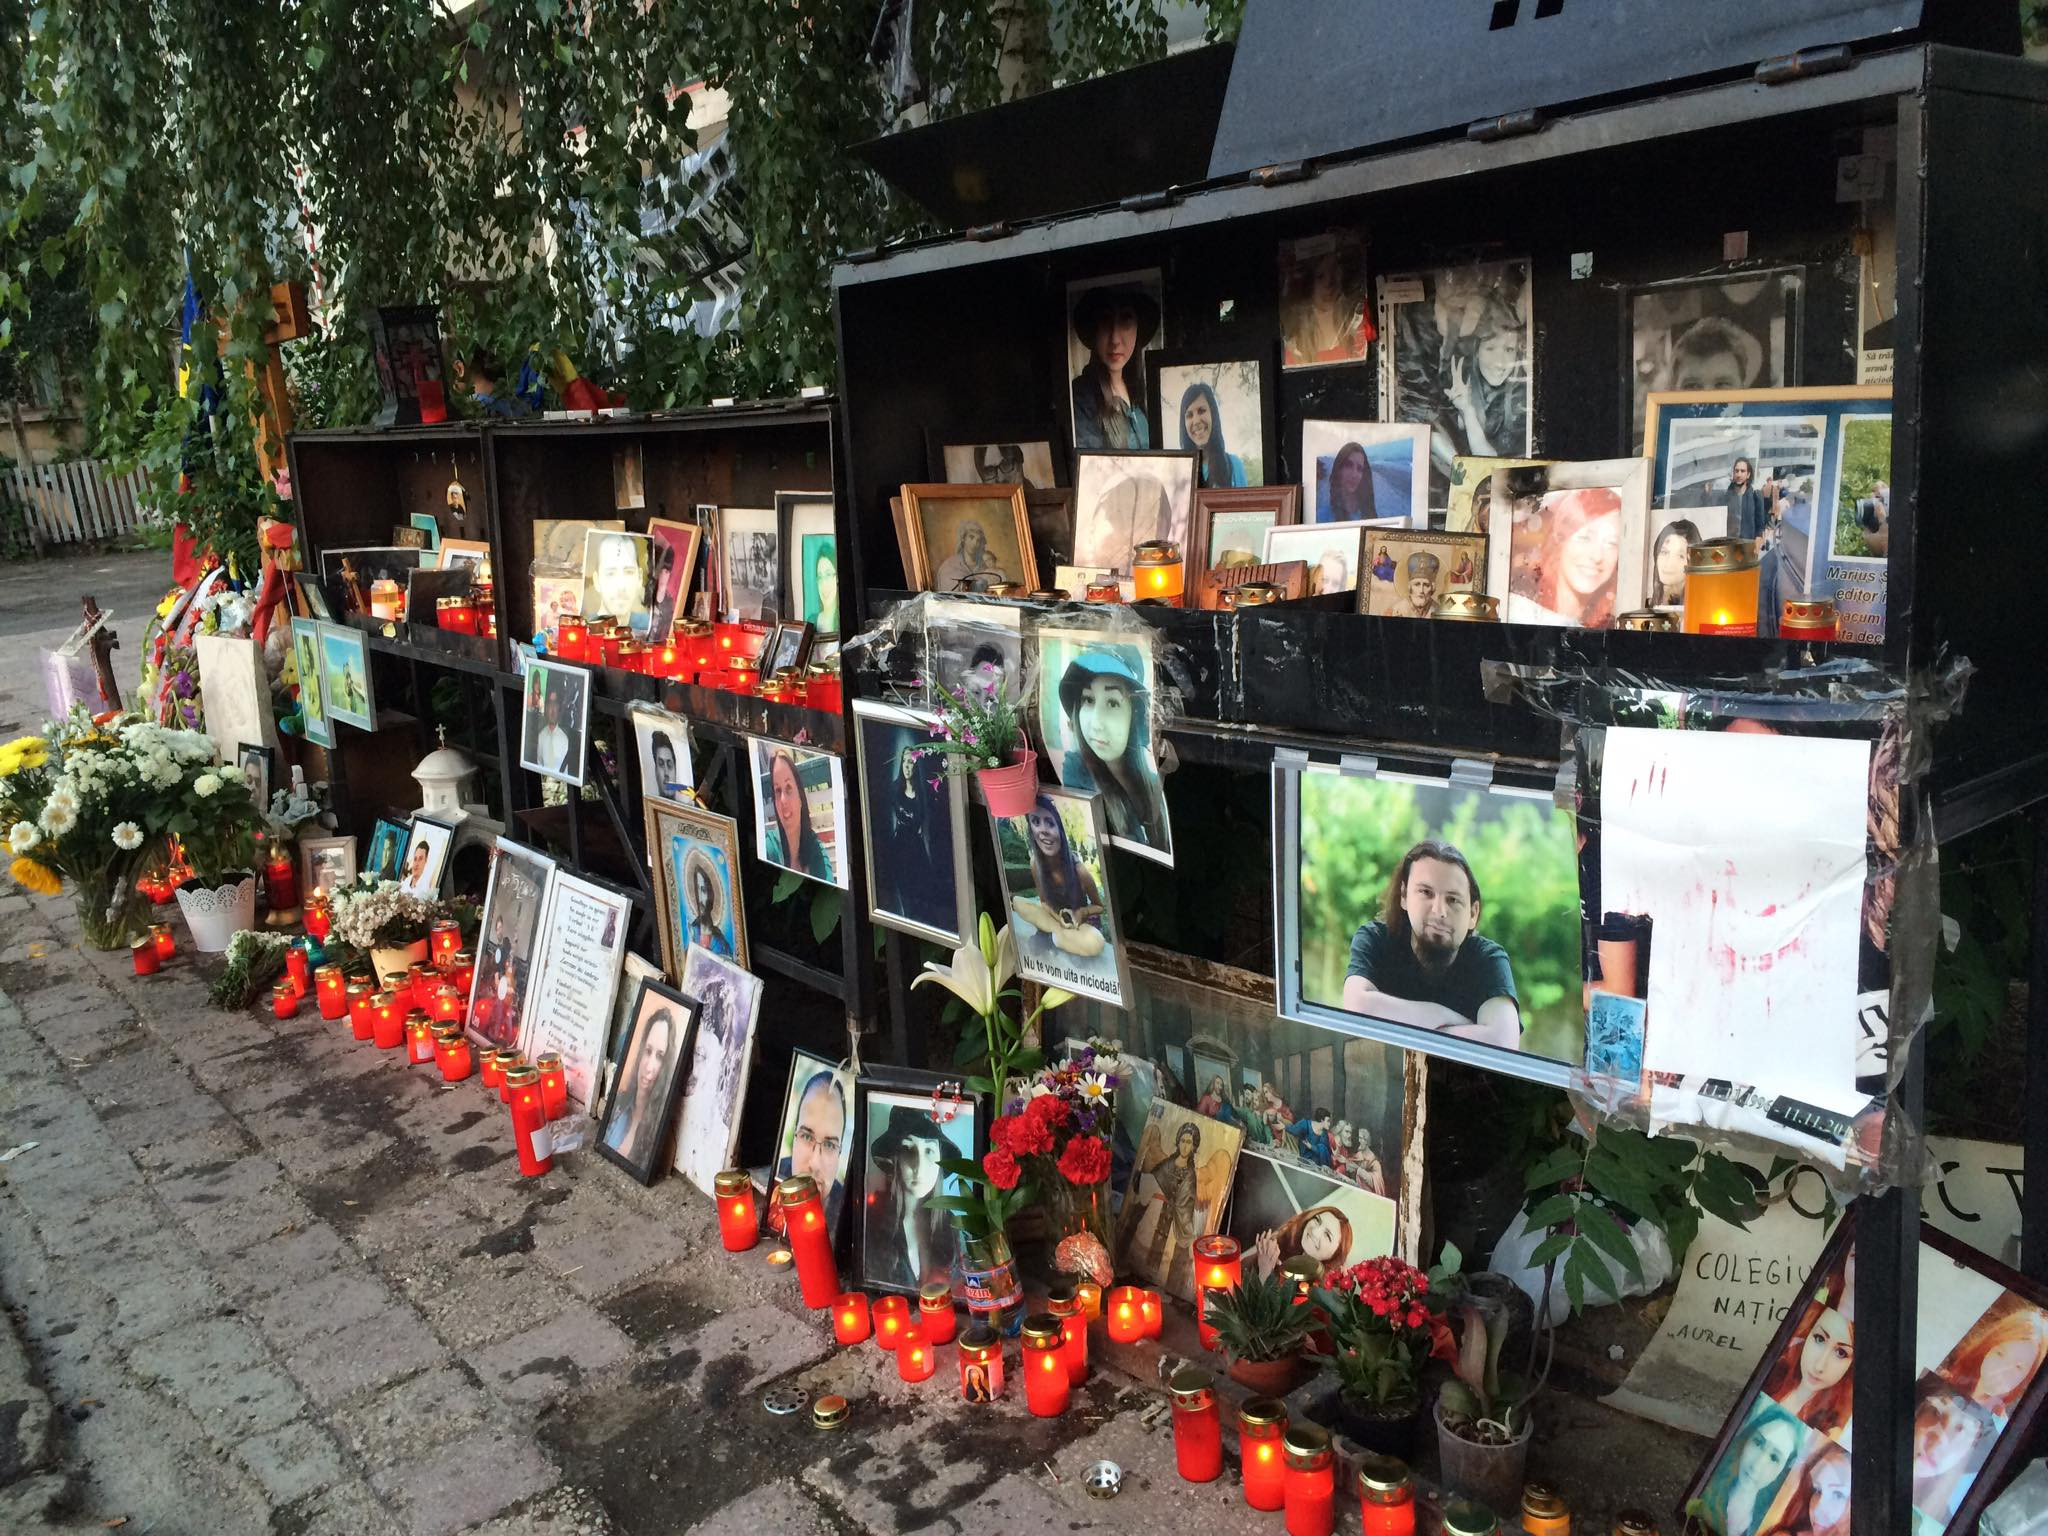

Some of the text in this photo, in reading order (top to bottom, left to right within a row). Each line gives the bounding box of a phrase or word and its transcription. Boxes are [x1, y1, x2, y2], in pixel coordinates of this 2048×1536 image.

[1827, 566, 1876, 582] Marius
[1836, 587, 1878, 603] editor
[1843, 611, 1881, 625] acum
[1023, 955, 1035, 970] Nu
[1036, 959, 1045, 973] te
[1045, 963, 1062, 979] vom
[1063, 968, 1079, 984] uita
